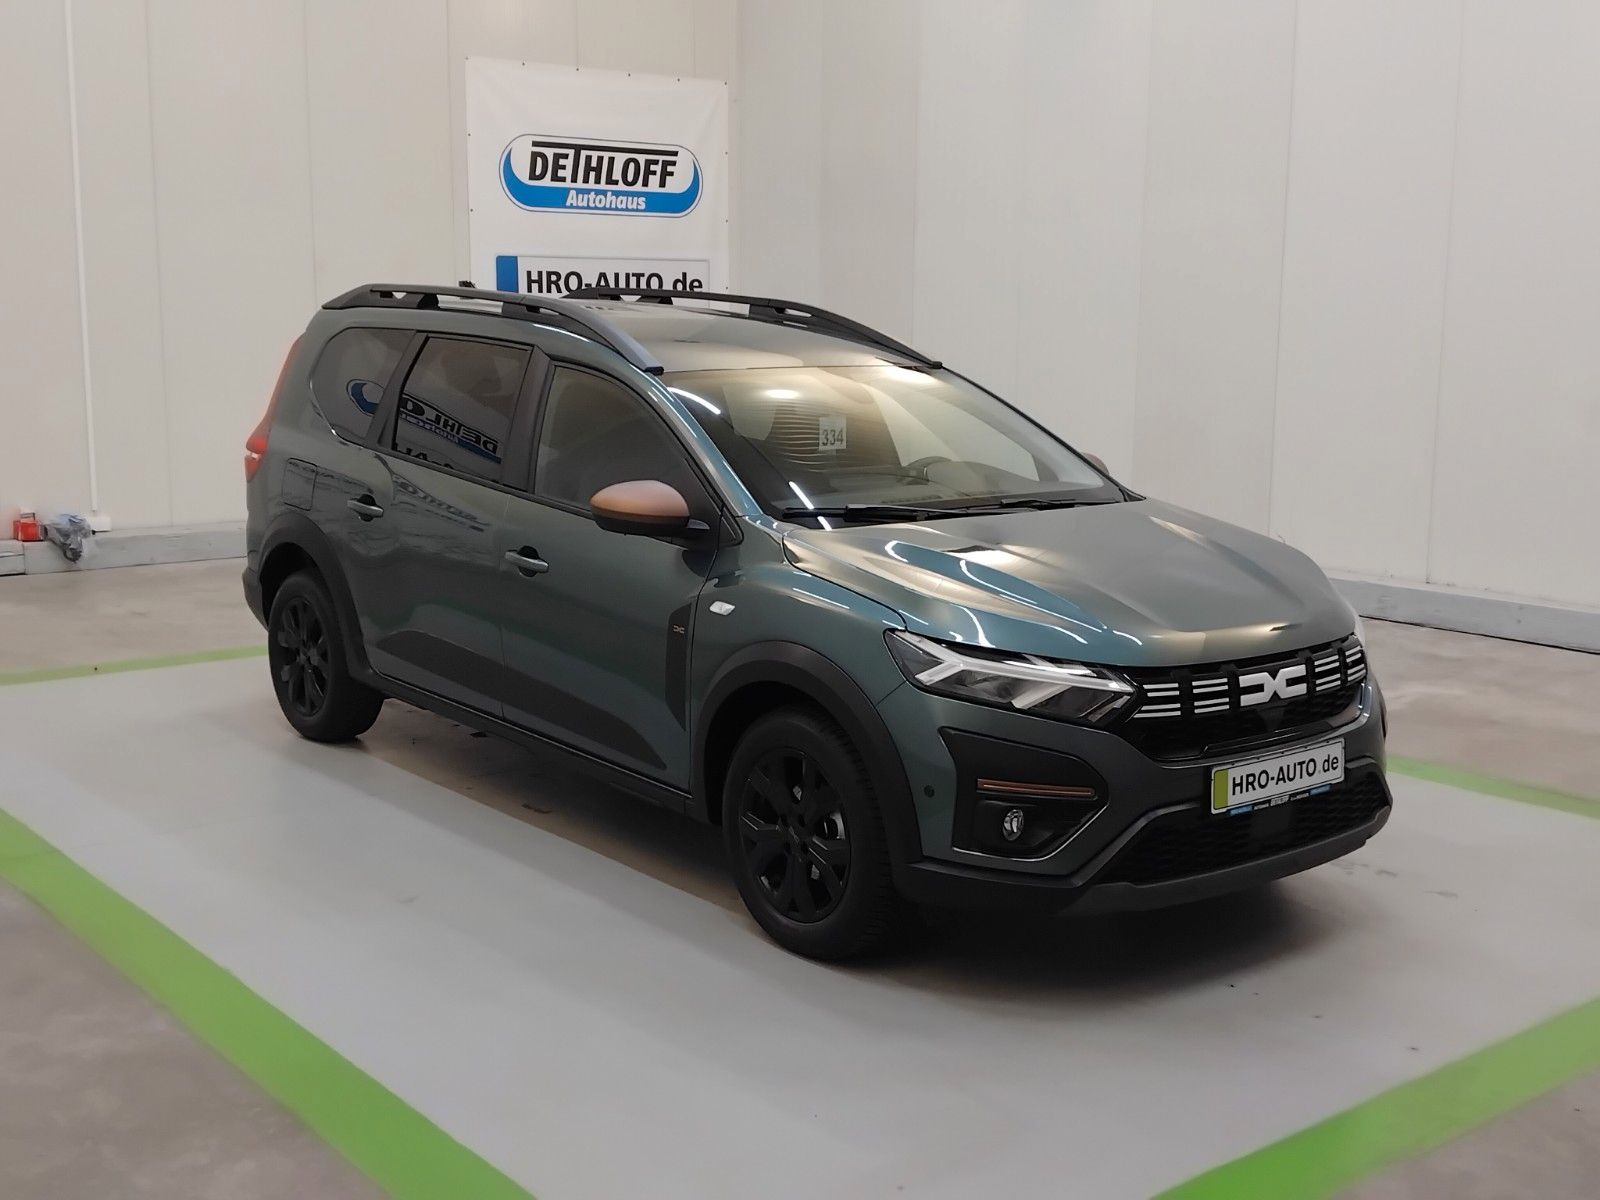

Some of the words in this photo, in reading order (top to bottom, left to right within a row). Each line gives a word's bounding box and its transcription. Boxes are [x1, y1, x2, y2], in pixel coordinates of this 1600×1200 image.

[528, 141, 679, 188] DETHLOFF
[566, 189, 646, 210] Autohaus
[821, 428, 844, 446] 334
